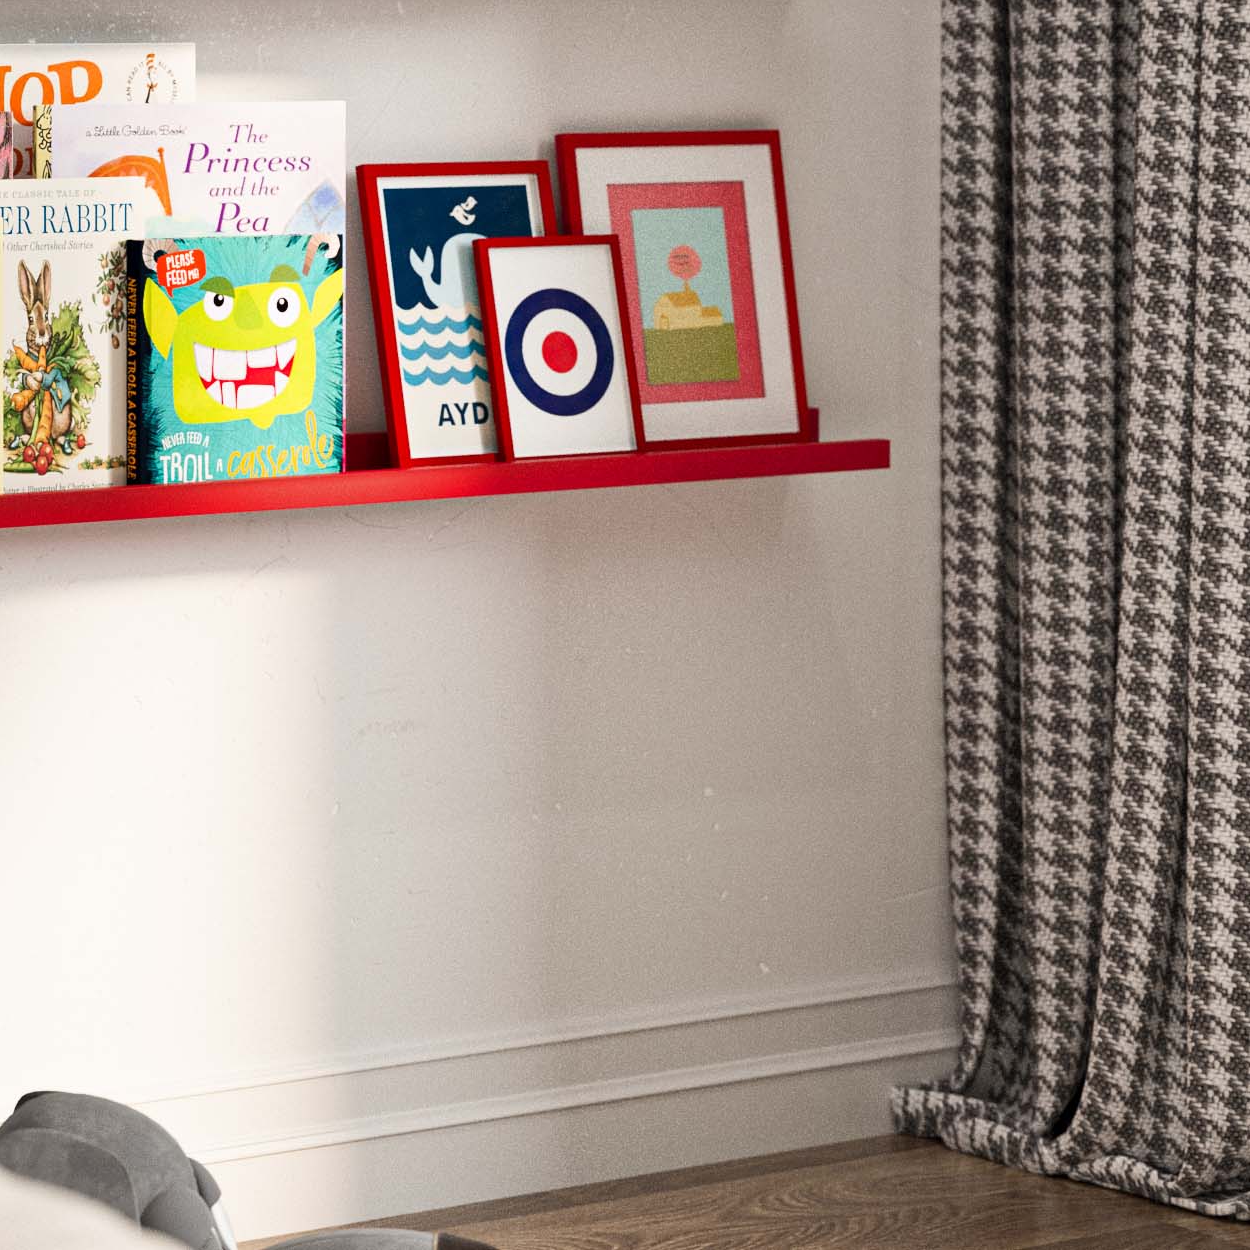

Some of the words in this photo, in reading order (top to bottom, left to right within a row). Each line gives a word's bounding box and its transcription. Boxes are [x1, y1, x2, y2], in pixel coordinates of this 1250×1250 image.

[94, 125, 120, 138] Little
[121, 124, 158, 137] Golden
[229, 124, 269, 144] The
[183, 141, 312, 174] Princess
[12, 190, 53, 199] CLASSIC
[56, 189, 80, 198] TALE
[208, 176, 245, 199] and
[250, 175, 280, 197] the
[42, 203, 133, 234] RABBIT
[215, 202, 270, 234] Pea
[6, 241, 29, 251] Other
[30, 240, 67, 252] Cherished
[68, 240, 94, 250] Stories
[165, 250, 195, 271] PLEASE
[166, 269, 187, 287] FEED
[126, 277, 137, 316] NEVER
[126, 318, 137, 346] FEED
[126, 359, 137, 399] TROLL
[126, 412, 137, 480] CASSEROLE
[160, 452, 214, 485] TROLL
[216, 458, 223, 472] A
[227, 410, 335, 478] casserole
[161, 432, 184, 451] NEVER
[186, 430, 202, 448] FEED
[203, 434, 210, 447] A
